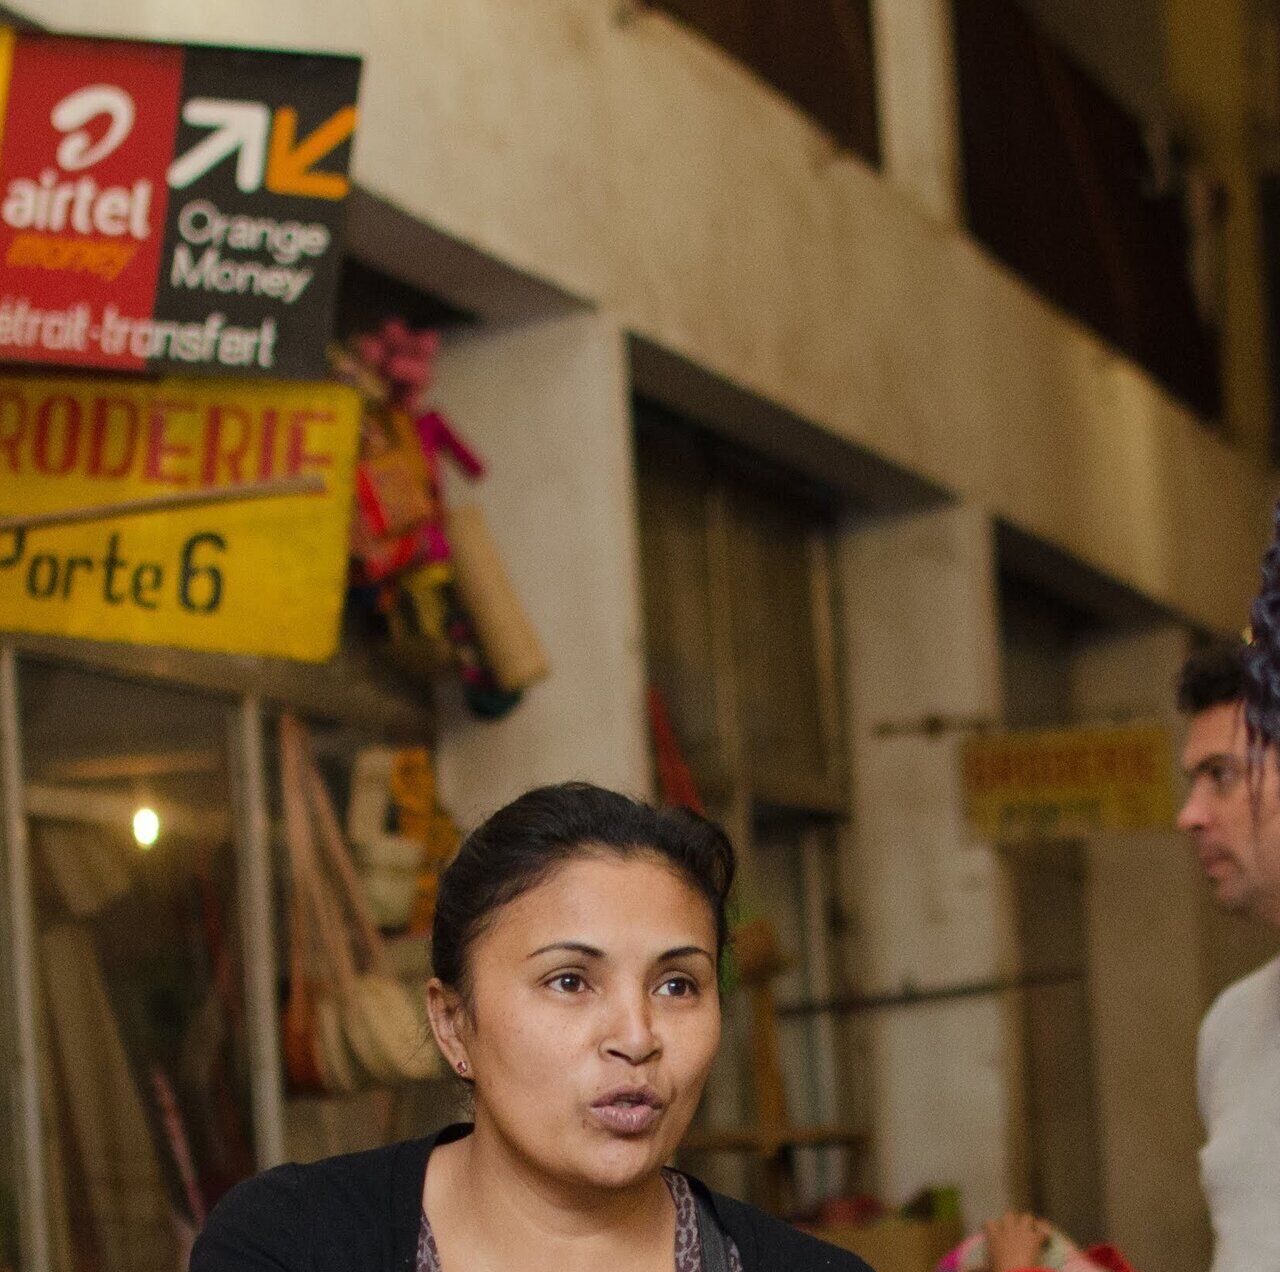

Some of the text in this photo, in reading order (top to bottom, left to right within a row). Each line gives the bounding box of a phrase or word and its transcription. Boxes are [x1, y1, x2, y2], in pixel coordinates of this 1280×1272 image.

[1, 168, 153, 240] airtel
[178, 199, 331, 265] Orange
[171, 242, 314, 303] Money
[177, 530, 228, 614] 6
